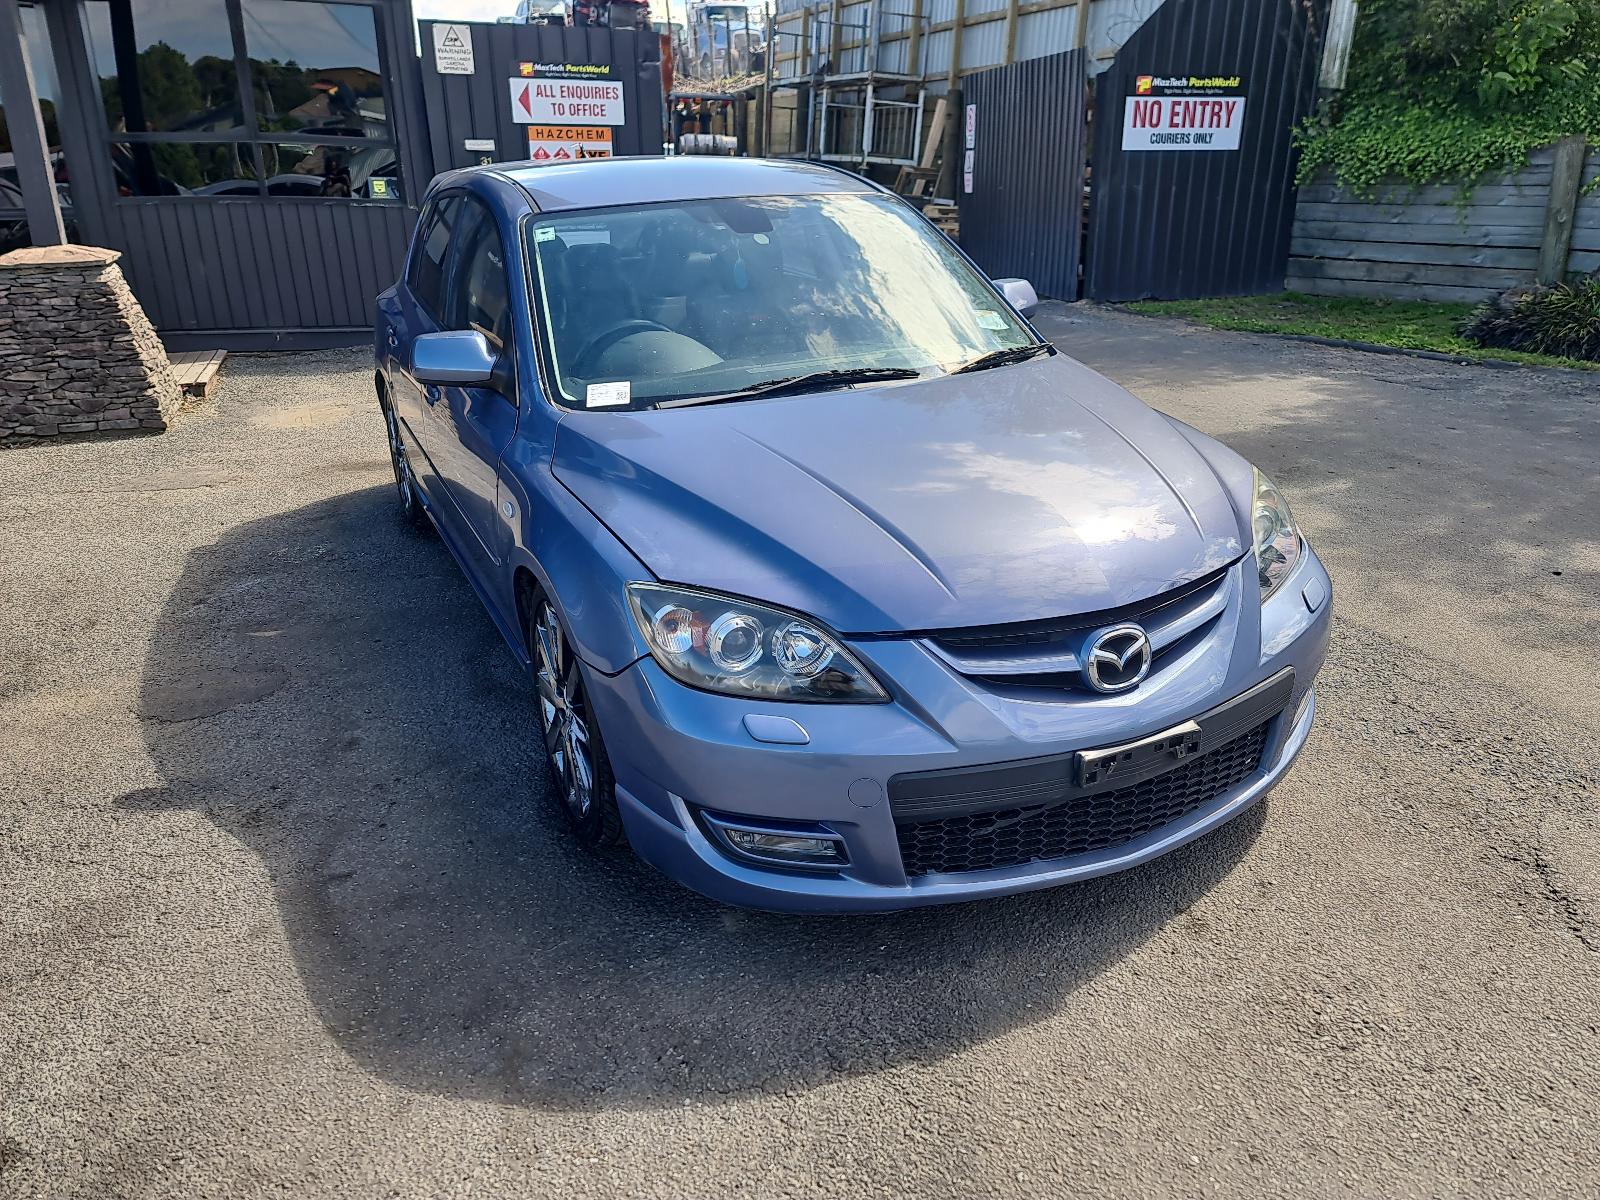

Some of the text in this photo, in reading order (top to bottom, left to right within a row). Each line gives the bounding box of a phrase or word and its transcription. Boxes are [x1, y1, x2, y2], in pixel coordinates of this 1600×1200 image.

[565, 64, 610, 75] PartsWorld
[1188, 77, 1240, 87] PartsWorld
[535, 84, 619, 100] ALL ENQUIRIES
[551, 102, 607, 117] TO OFFICE
[1132, 100, 1237, 128] NO ENTRY
[535, 128, 605, 140] HAZCHEM
[1150, 132, 1214, 144] COURIERS ONLY
[480, 156, 492, 166] 31
